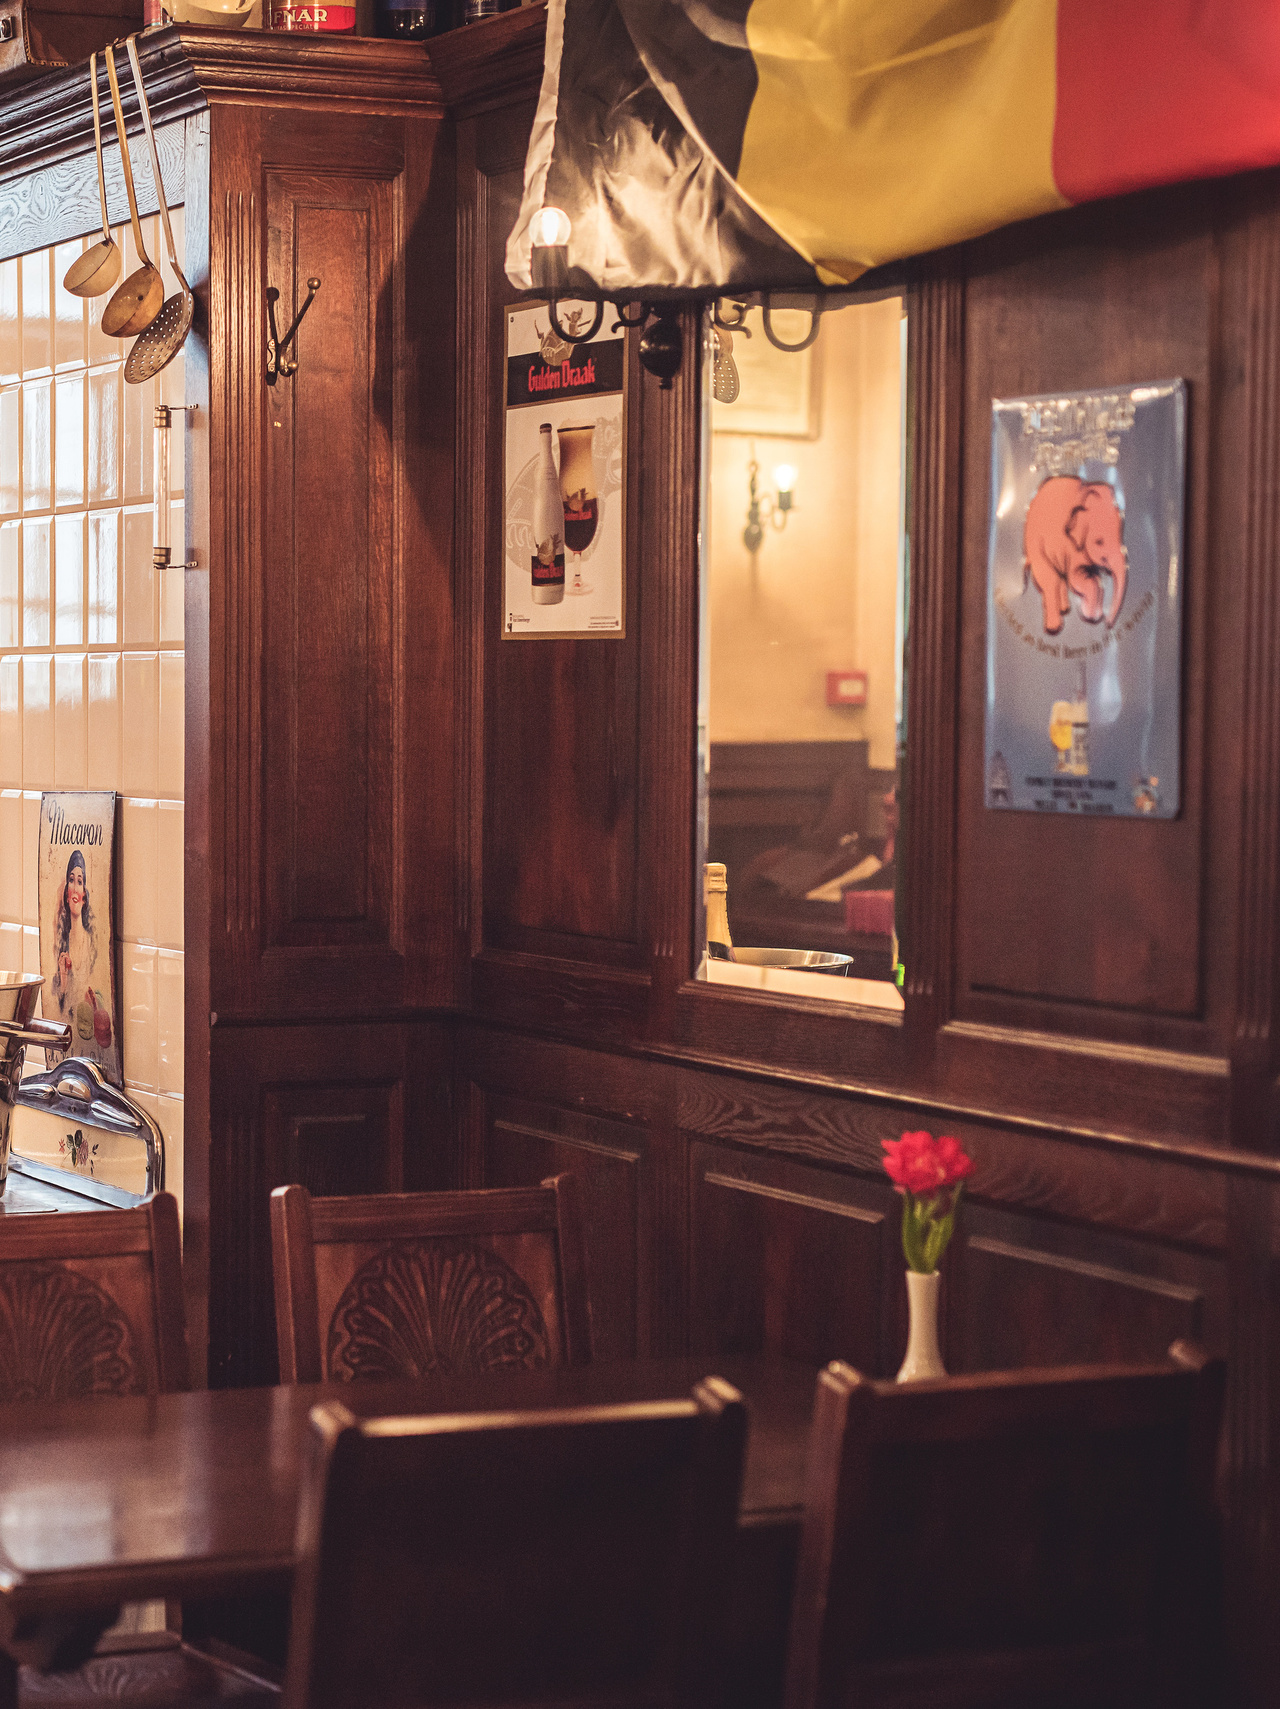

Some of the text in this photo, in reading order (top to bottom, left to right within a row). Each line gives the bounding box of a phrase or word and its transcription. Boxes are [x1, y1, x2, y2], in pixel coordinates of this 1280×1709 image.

[528, 358, 596, 392] Gulden Draak
[48, 799, 104, 847] Macaron
